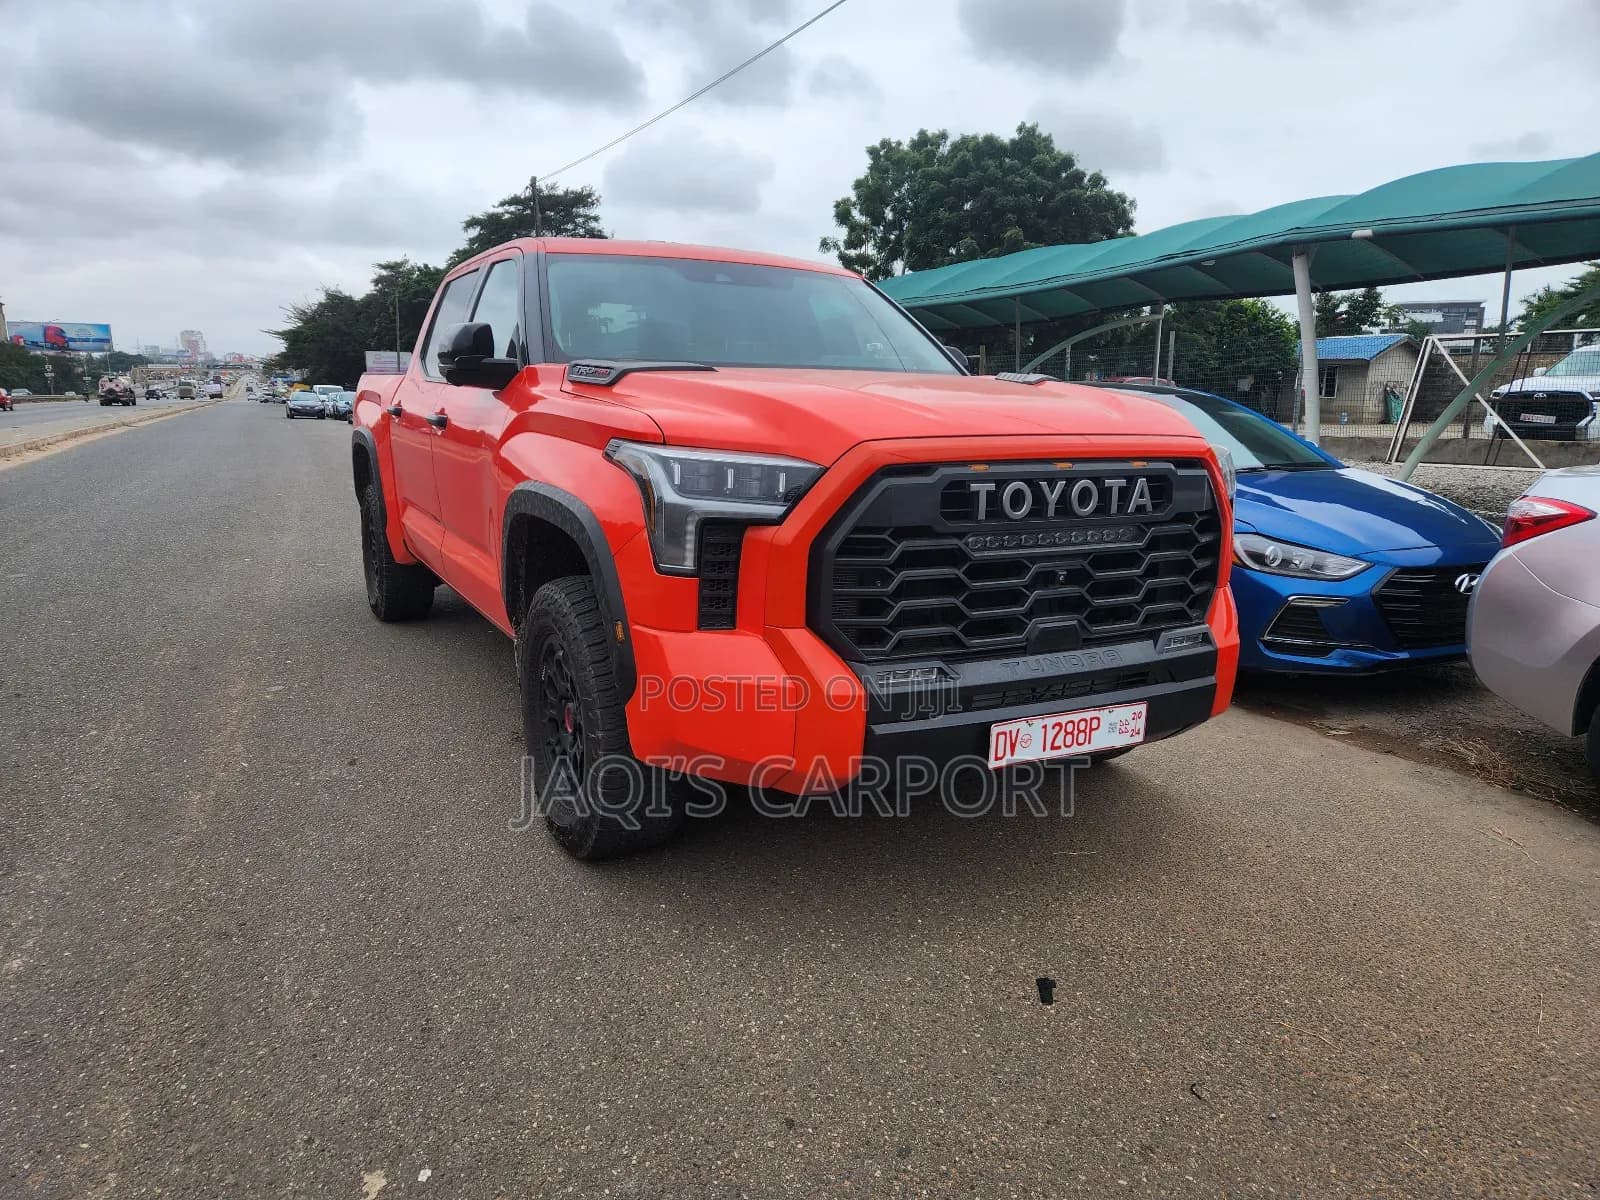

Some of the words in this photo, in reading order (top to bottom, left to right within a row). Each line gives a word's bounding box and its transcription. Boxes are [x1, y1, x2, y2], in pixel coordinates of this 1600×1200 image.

[970, 478, 1153, 521] TOYOTA
[1001, 649, 1123, 679] TUNDRA
[994, 728, 1020, 761] DV
[1041, 716, 1101, 752] 1288P
